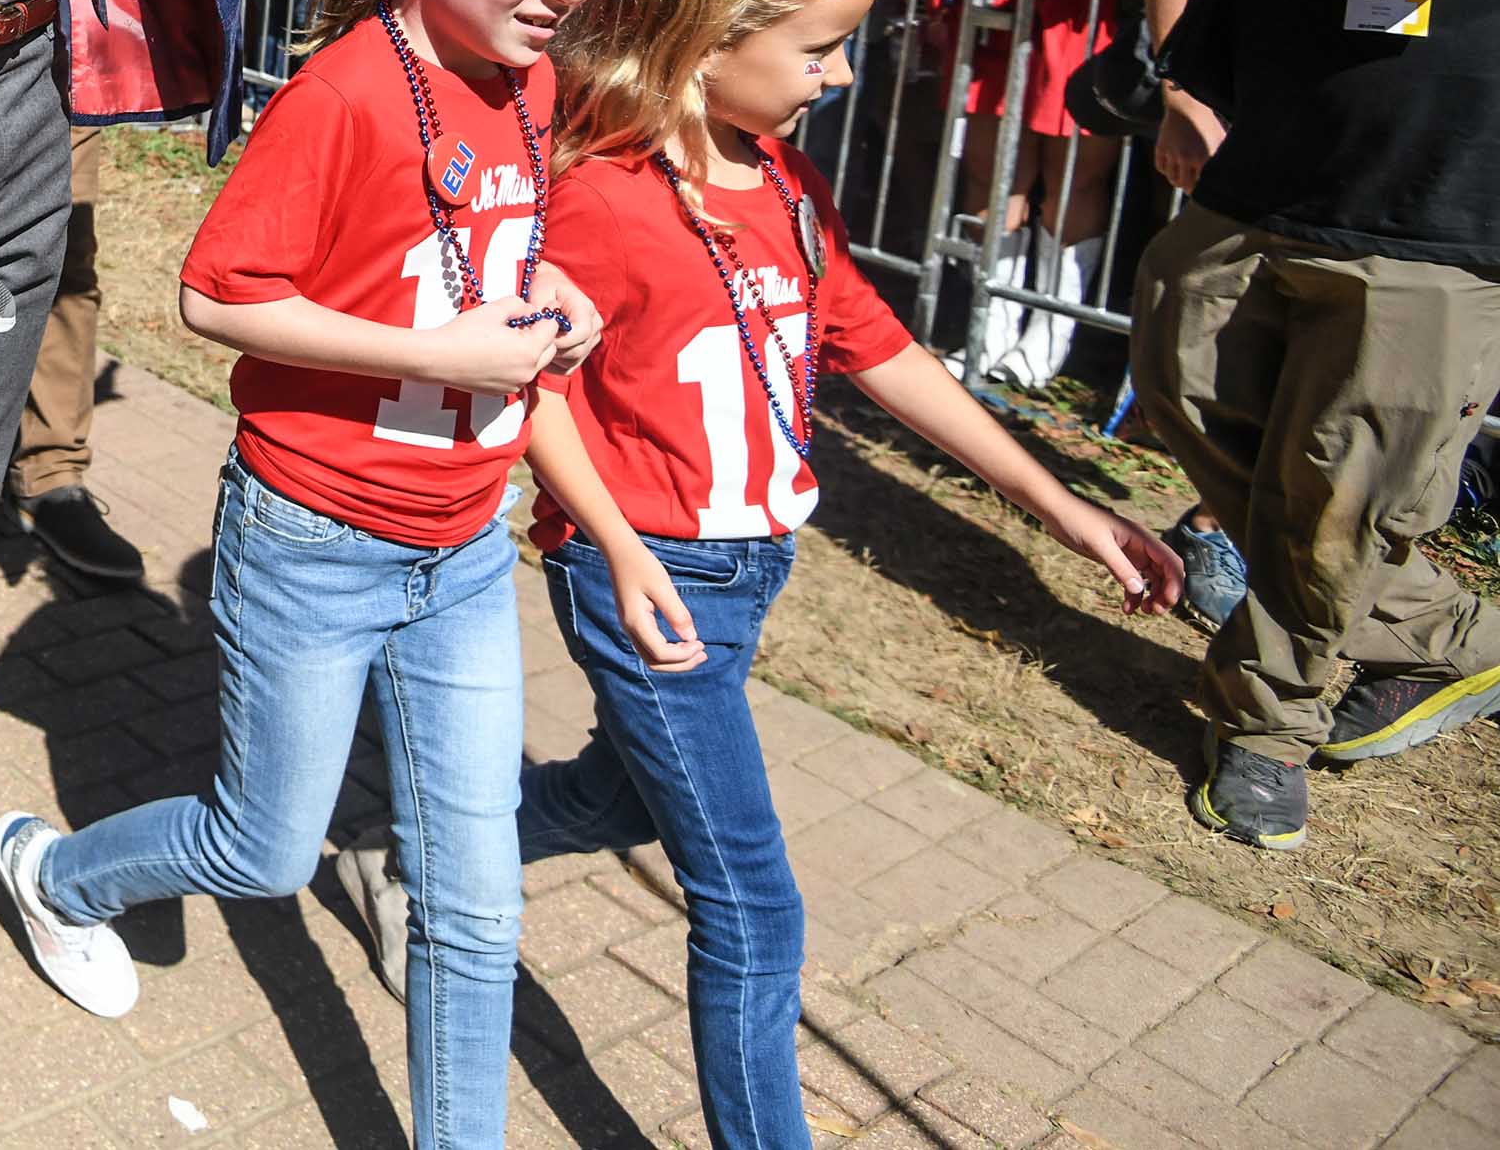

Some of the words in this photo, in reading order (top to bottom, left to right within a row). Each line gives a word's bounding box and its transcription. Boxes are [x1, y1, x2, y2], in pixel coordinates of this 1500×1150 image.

[441, 140, 476, 198] ELI
[373, 217, 536, 449] 10
[732, 268, 763, 312] Ole
[677, 311, 820, 540] 10
